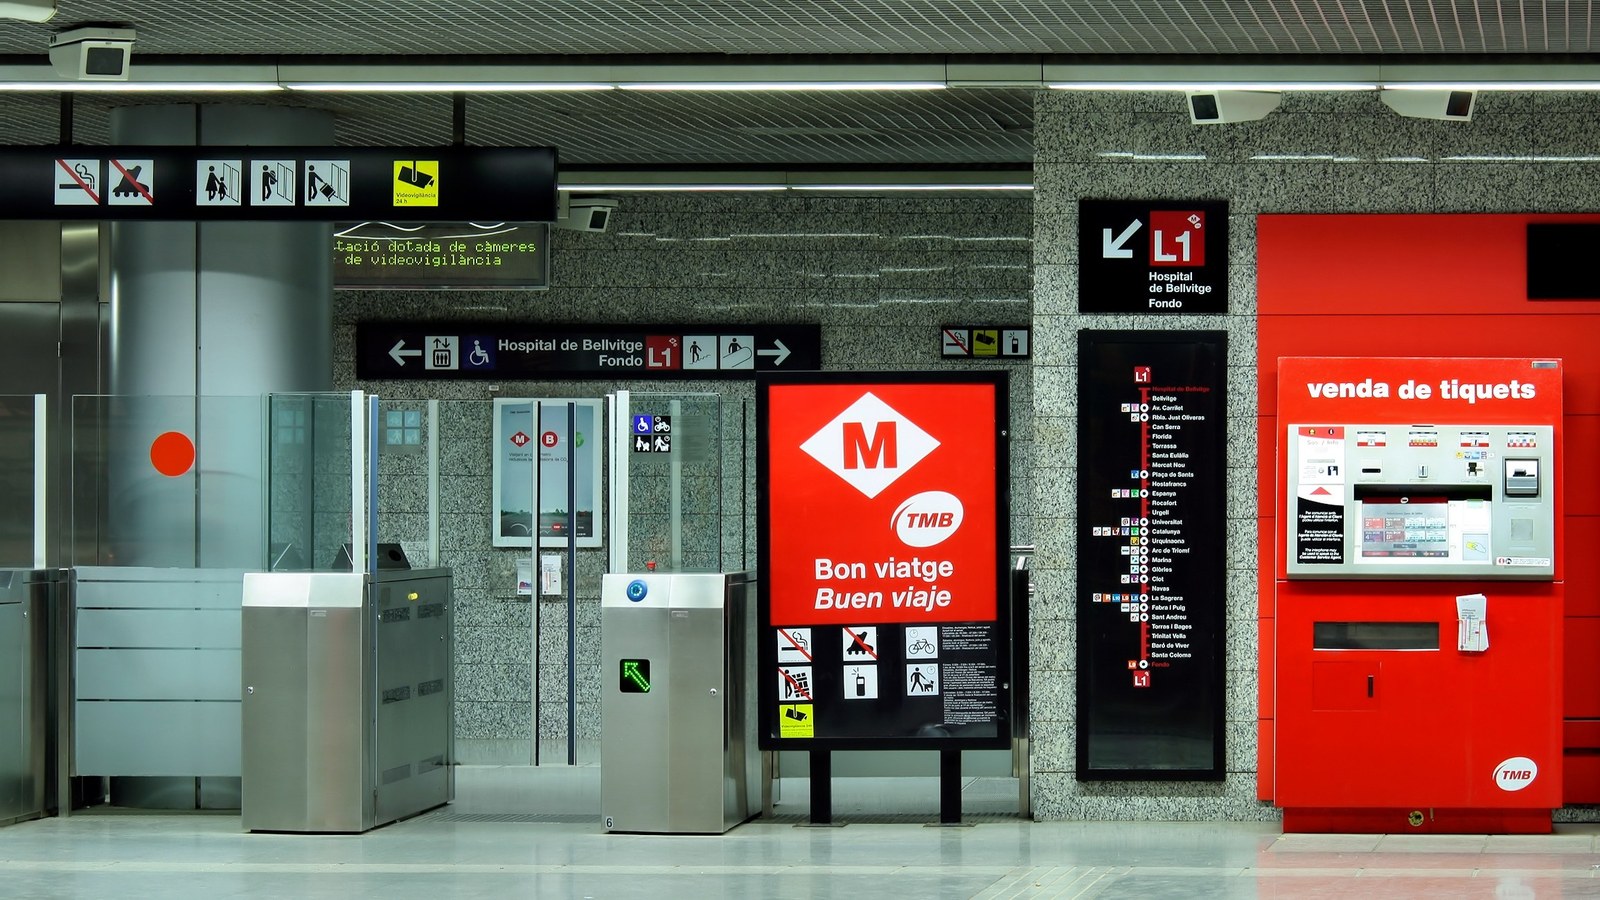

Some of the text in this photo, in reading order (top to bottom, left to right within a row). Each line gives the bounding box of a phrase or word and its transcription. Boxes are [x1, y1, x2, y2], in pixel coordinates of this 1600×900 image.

[334, 240, 536, 252] tació dotada de càmeres
[1154, 230, 1190, 262] L1
[345, 254, 502, 266] de videovigilància
[1149, 272, 1192, 283] Hospital
[1149, 284, 1212, 294] de Bellvitge
[1149, 298, 1182, 308] Fondo
[498, 339, 644, 353] Hospital de Bellvitge
[599, 354, 644, 366] Fondo
[648, 348, 670, 366] L1
[1136, 372, 1146, 382] L1
[1307, 378, 1536, 404] venda de tiquets
[516, 435, 524, 444] M
[546, 435, 554, 444] B
[842, 421, 898, 470] M
[906, 512, 954, 528] TMB
[816, 557, 954, 582] Bon viatge
[814, 586, 952, 612] Buen viaje
[1135, 676, 1146, 686] L1
[1502, 770, 1531, 780] TMB
[606, 818, 612, 828] 6
